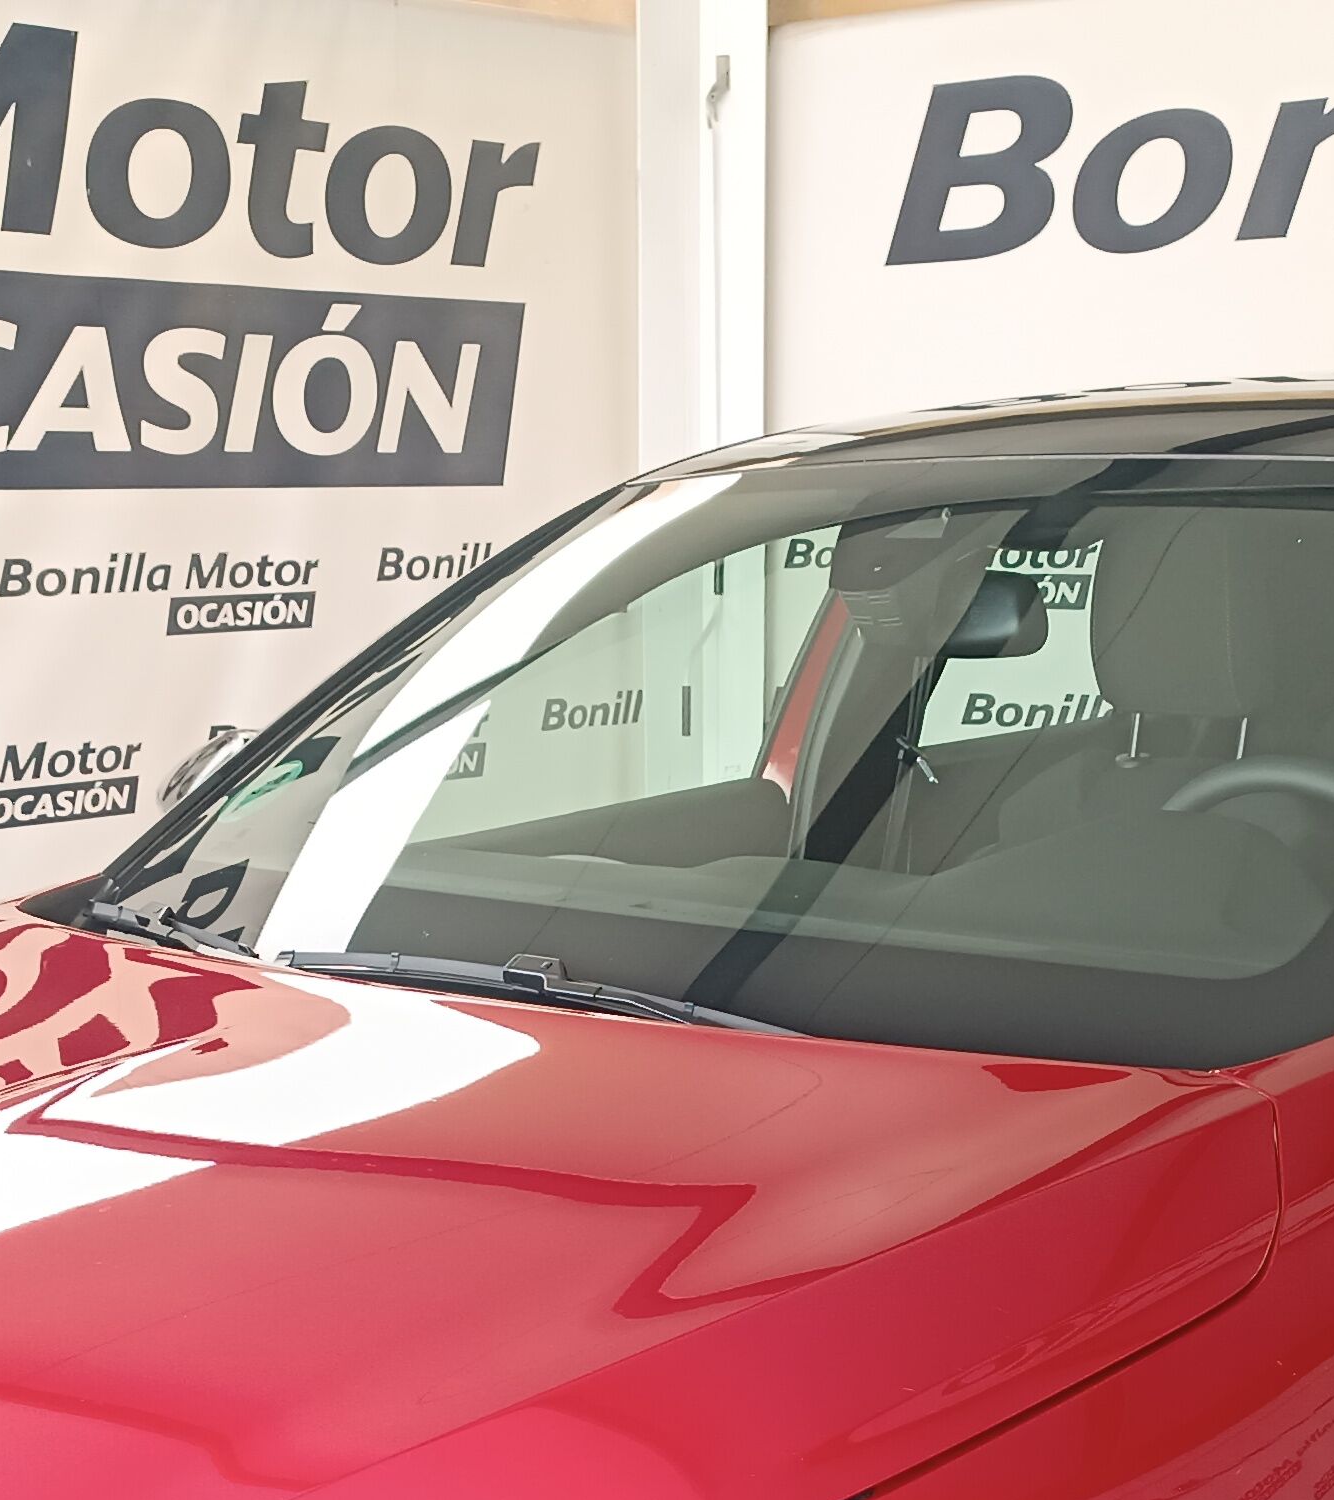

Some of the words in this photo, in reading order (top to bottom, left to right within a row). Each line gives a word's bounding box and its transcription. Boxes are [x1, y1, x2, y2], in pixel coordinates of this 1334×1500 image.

[185, 552, 319, 589] Motor
[177, 594, 308, 629] OCASIÓN
[0, 740, 142, 783] Motor
